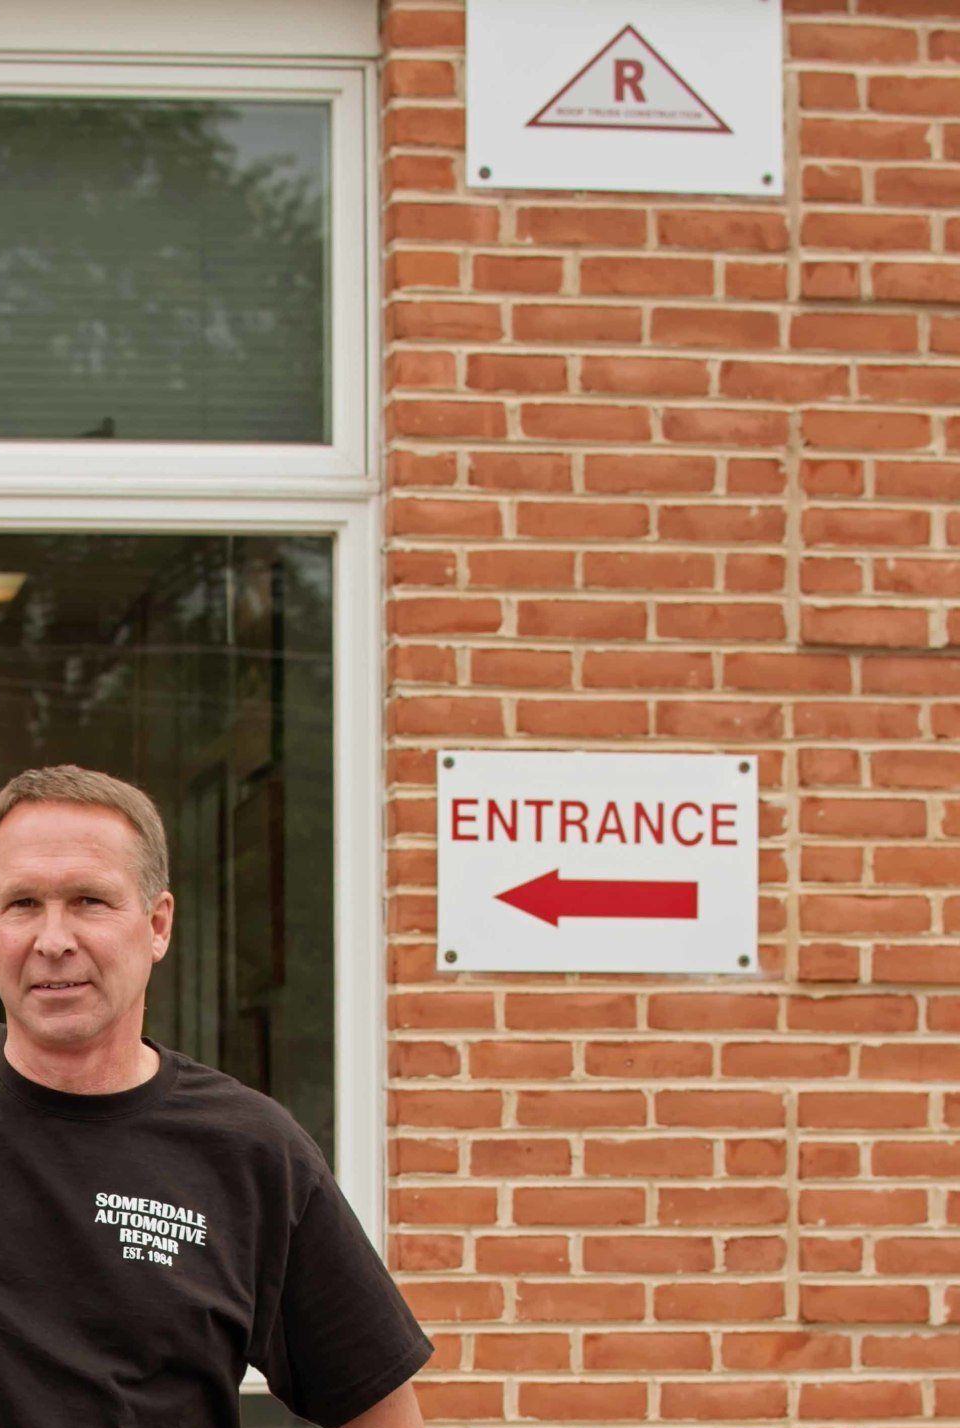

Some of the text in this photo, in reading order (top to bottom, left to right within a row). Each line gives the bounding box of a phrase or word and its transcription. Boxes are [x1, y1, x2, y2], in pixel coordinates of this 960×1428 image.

[614, 59, 646, 102] R
[451, 797, 738, 846] ENTRANCE
[94, 1209, 206, 1246] AUTOMOTIVE
[95, 1192, 207, 1229] SOMERDALE
[119, 1228, 179, 1254] REPAIR
[122, 1246, 145, 1260] EST.
